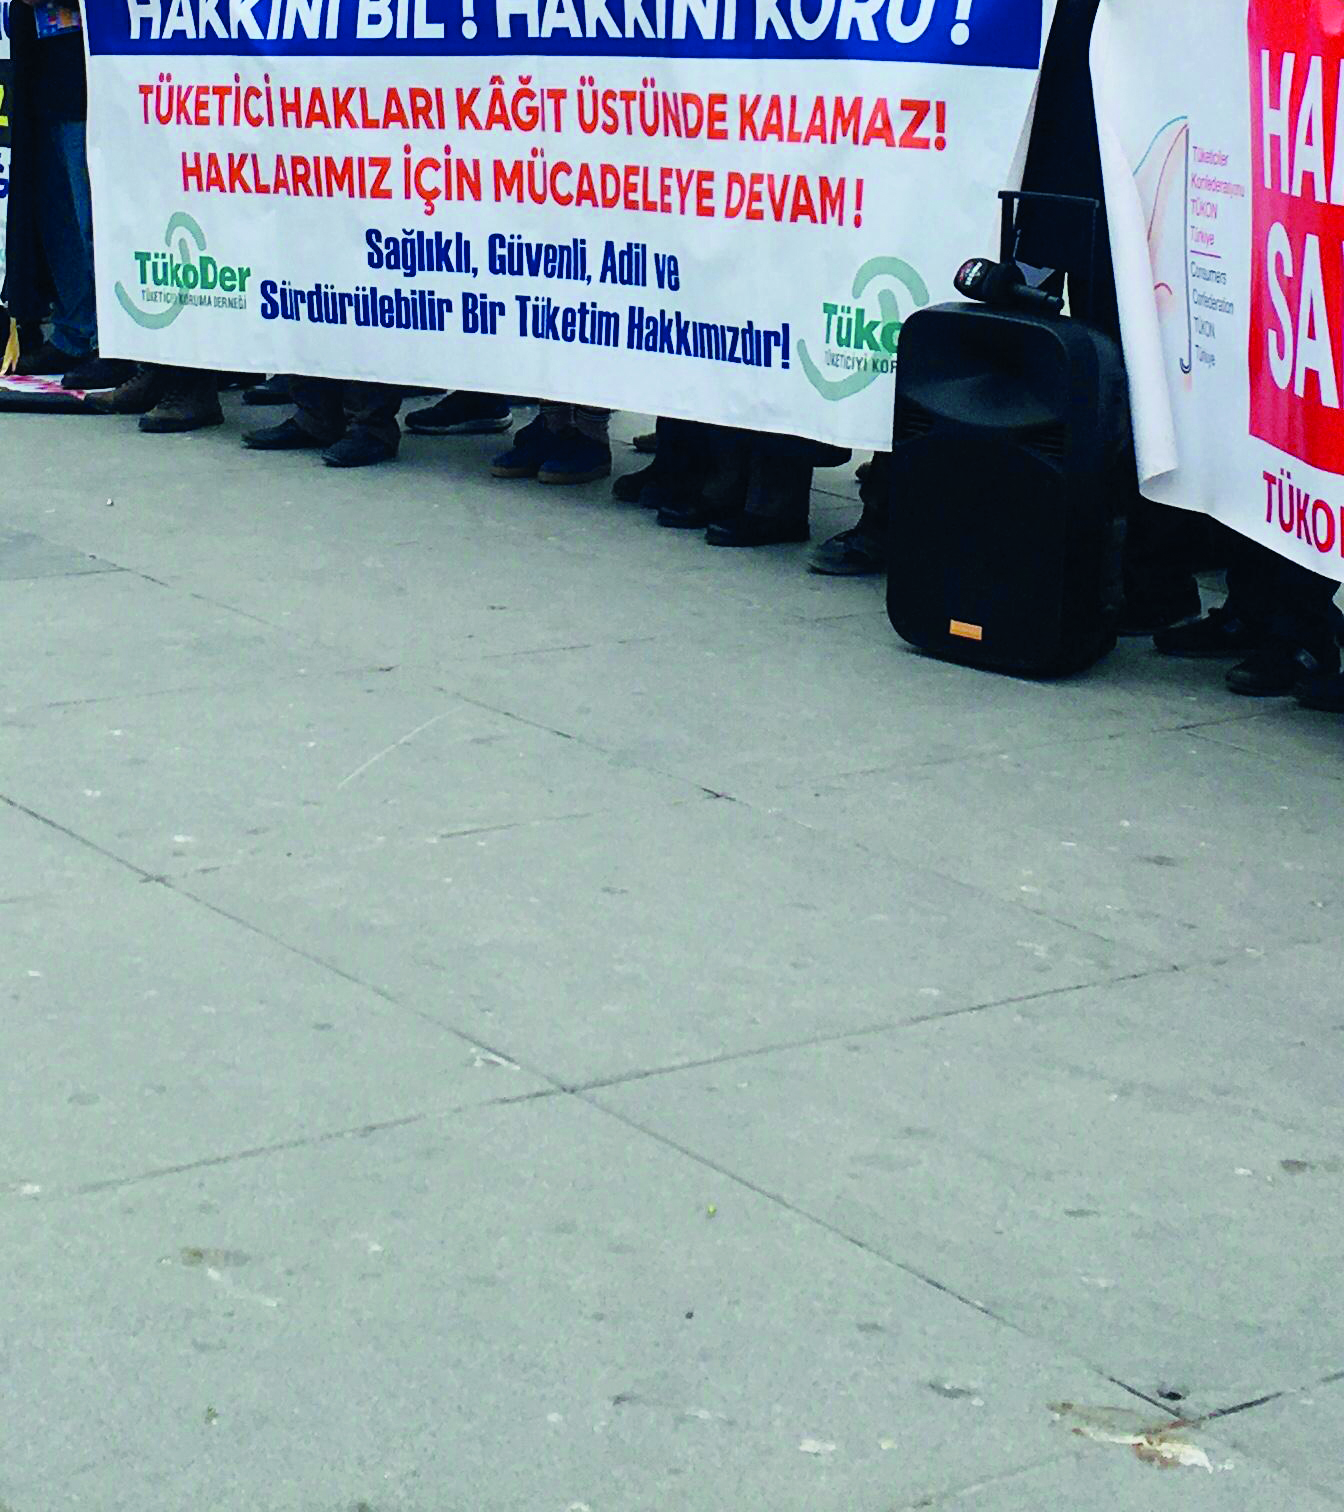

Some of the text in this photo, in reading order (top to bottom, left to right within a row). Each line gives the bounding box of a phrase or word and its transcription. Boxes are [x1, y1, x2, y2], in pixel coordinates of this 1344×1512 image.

[138, 72, 948, 151] TÜKETİCİ HAKLARI KÂĞIT ÜSTÜNDE KALAMAZ!
[181, 150, 394, 200] HAKLARIMIZ
[403, 143, 482, 217] İÇİN
[493, 147, 716, 219] MÜCADELEYE
[724, 172, 846, 226] DEVAM
[133, 250, 252, 293] TükoDer
[364, 227, 682, 292] Sağlıklı, Güvenli, Adil ve
[259, 279, 792, 370] Sürdürülebilir Bir Tüketim Hakkımızdır!
[822, 301, 903, 355] Tüko
